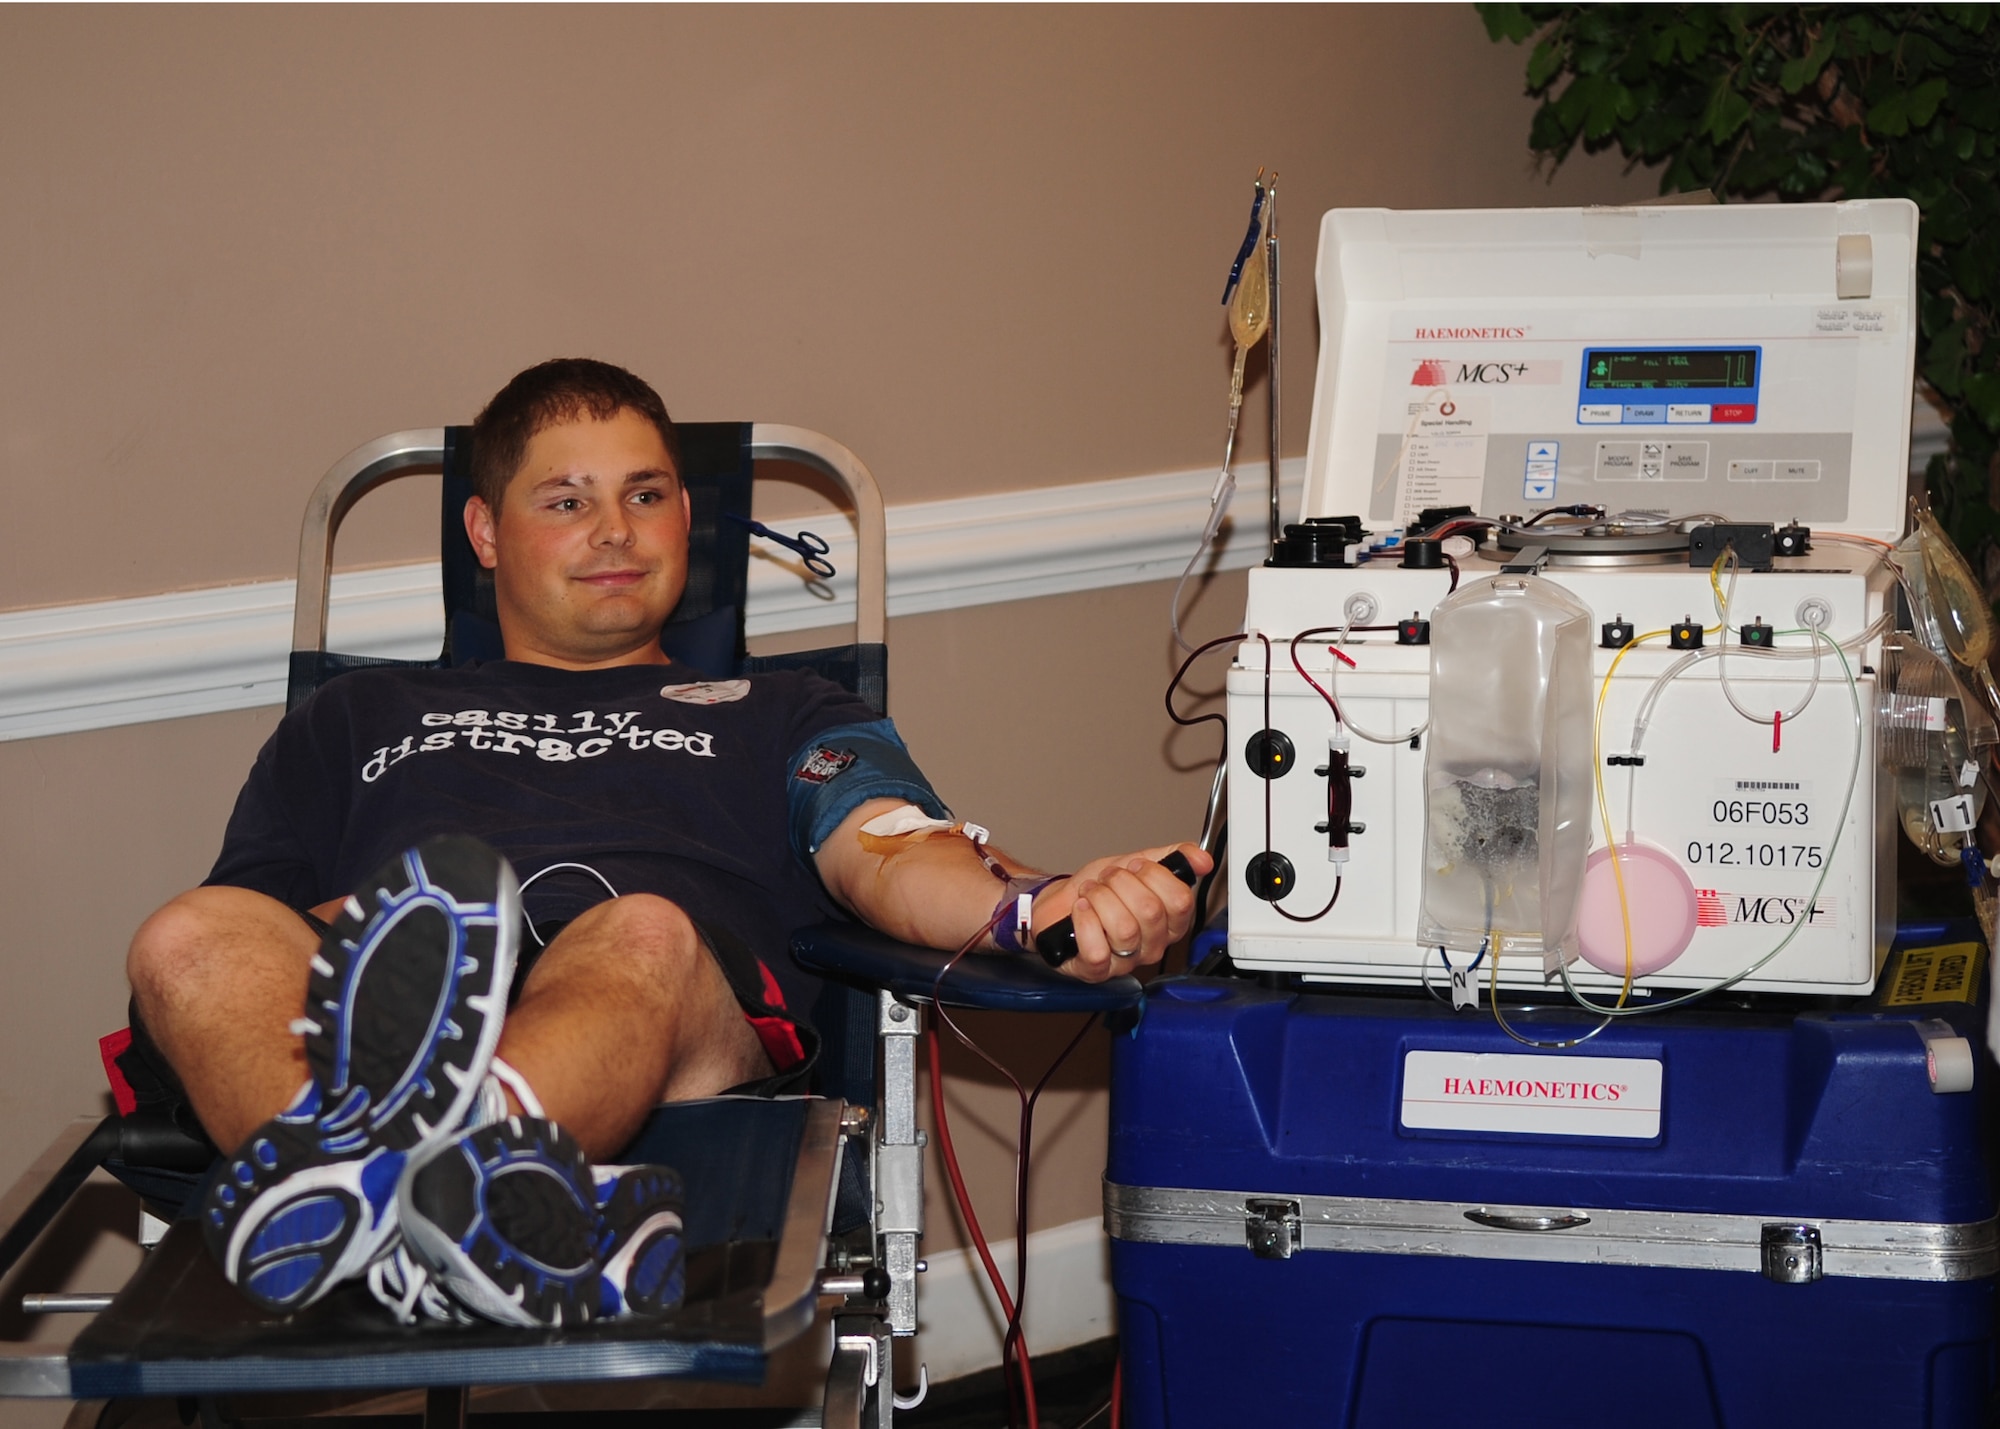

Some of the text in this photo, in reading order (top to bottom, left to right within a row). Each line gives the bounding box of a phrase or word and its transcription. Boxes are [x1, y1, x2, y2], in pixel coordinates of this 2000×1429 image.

[1445, 419, 1473, 427] Handling
[421, 710, 642, 736] easily
[361, 725, 717, 783] distracted
[1713, 800, 1809, 825] 06F053
[1687, 841, 1823, 868] 012.10175
[1904, 952, 1934, 969] LIFT
[1933, 955, 1968, 991] REQUIRED
[1453, 971, 1466, 988] 2
[1895, 968, 1930, 997] PERSON
